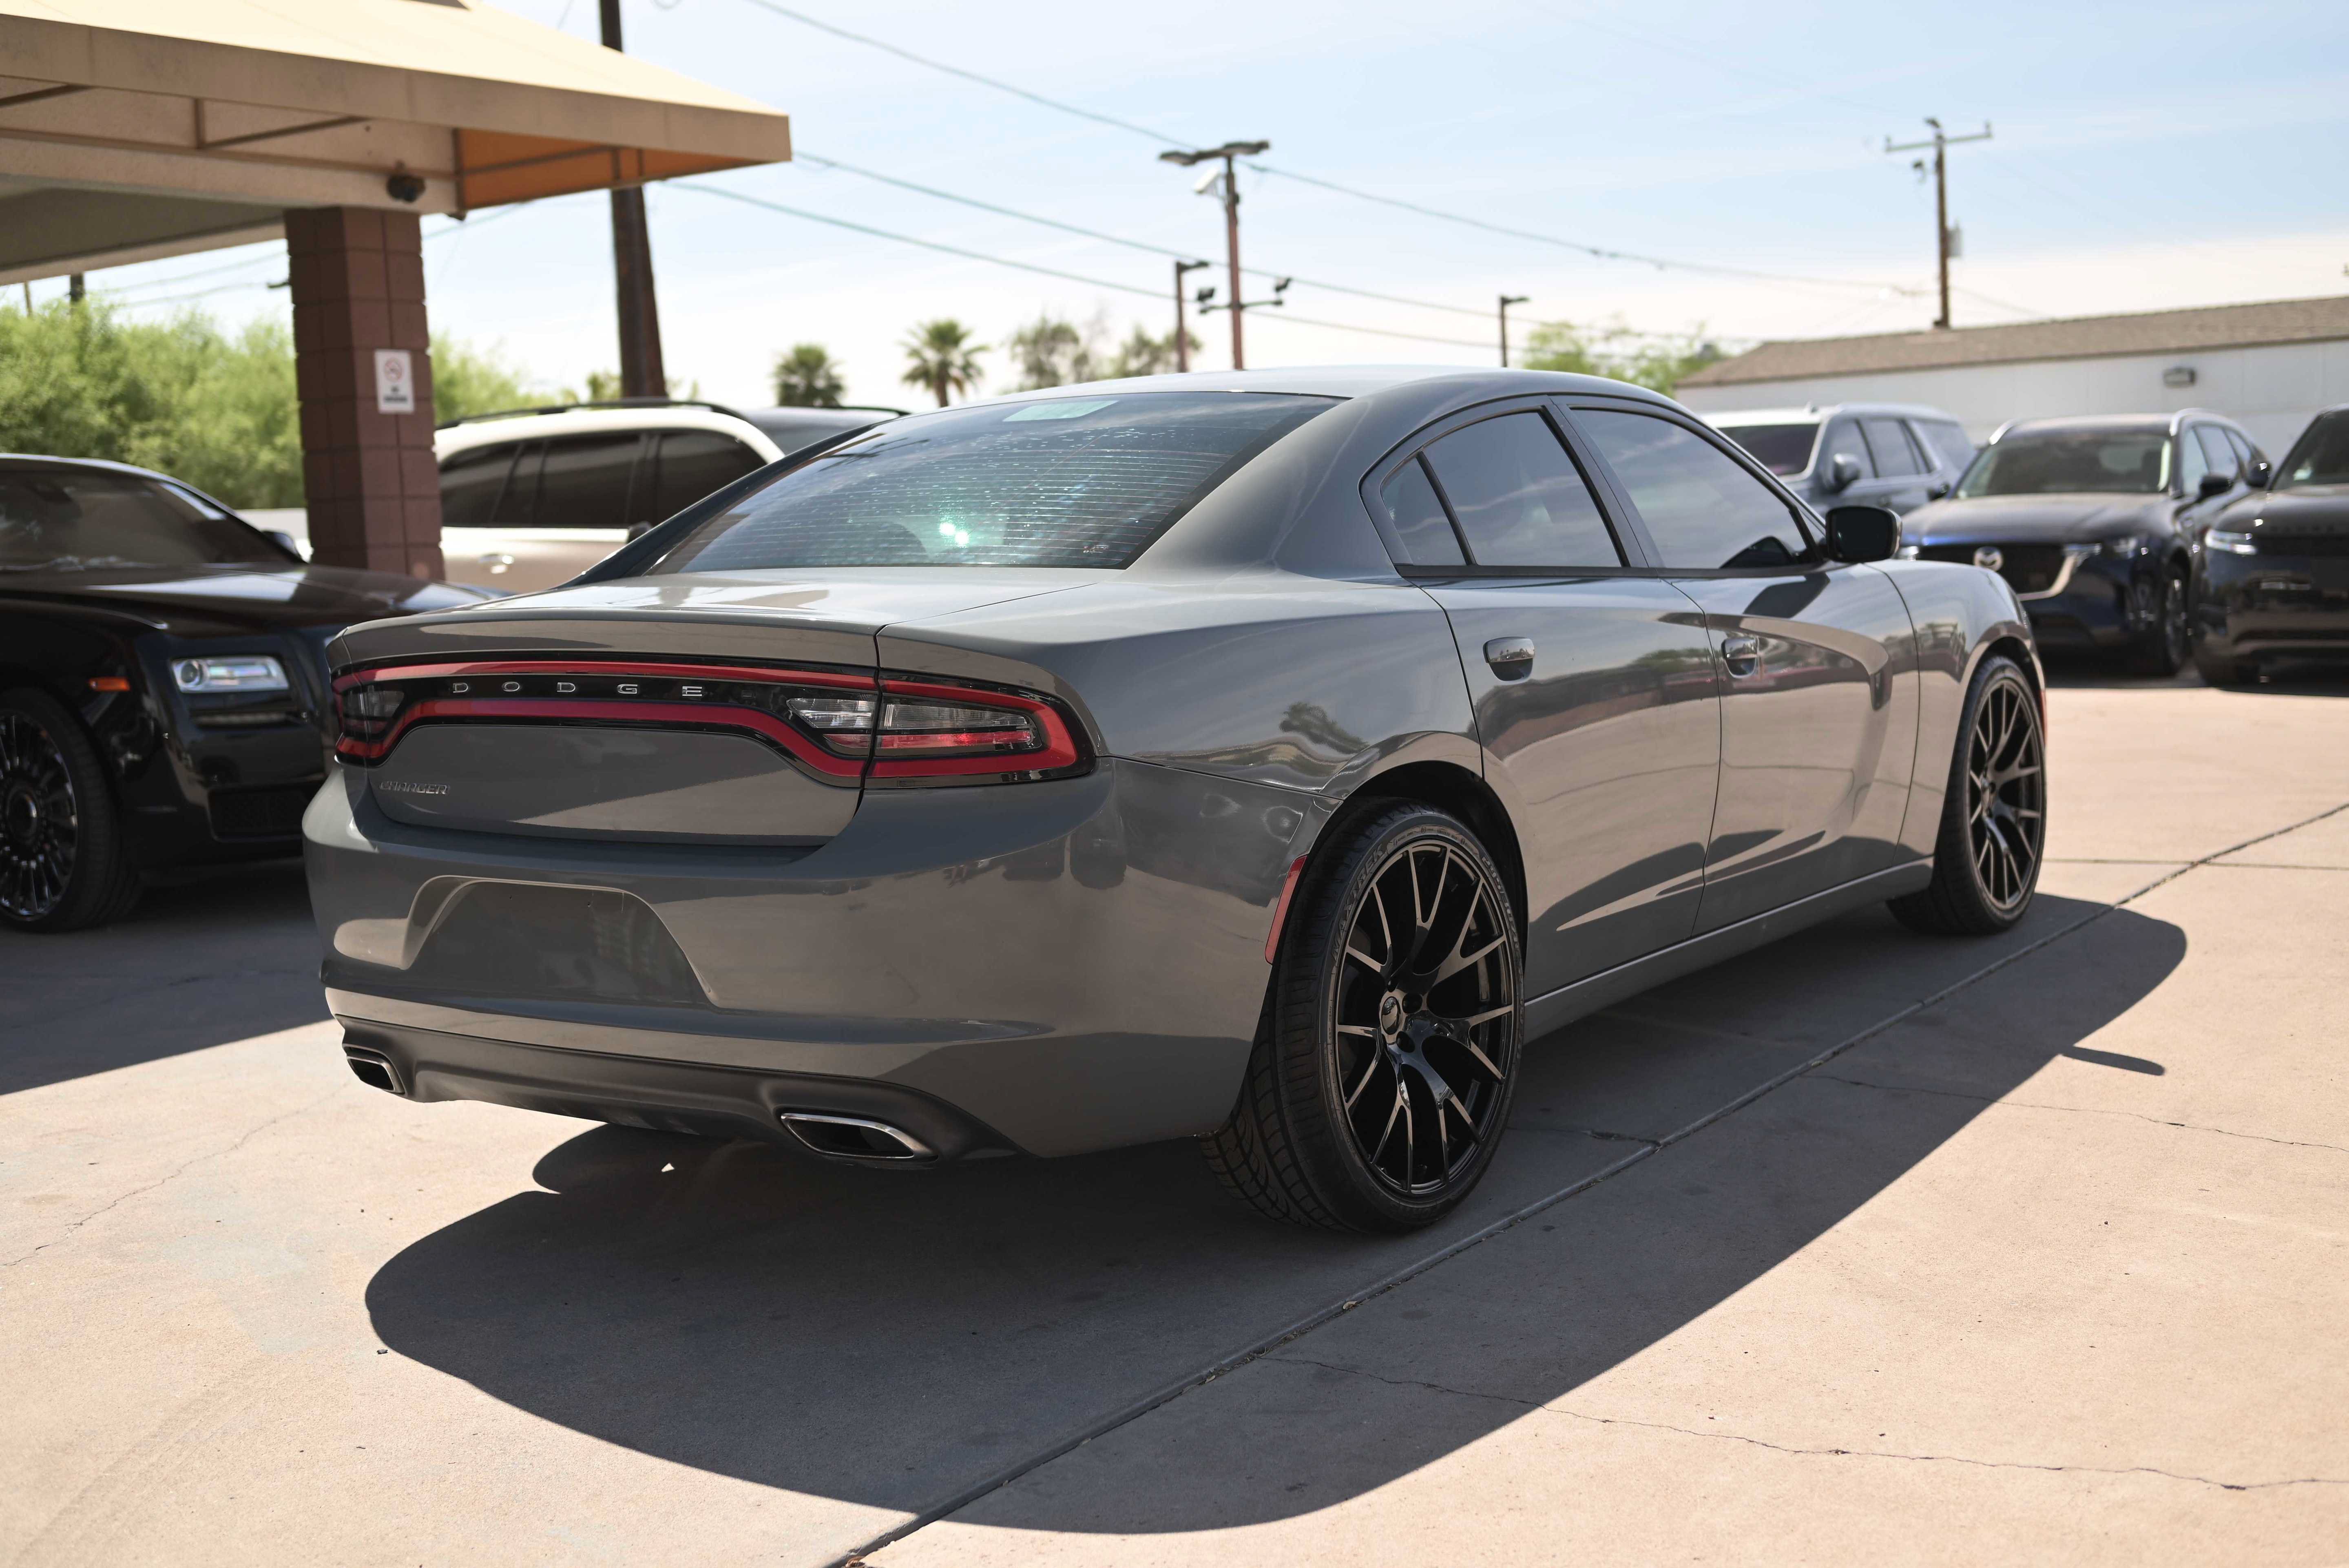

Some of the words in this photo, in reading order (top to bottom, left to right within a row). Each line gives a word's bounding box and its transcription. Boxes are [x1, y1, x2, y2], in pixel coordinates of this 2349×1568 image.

[452, 681, 703, 697] DODGE
[379, 781, 450, 794] CHARGER
[1332, 843, 1383, 962] MAXTREK
